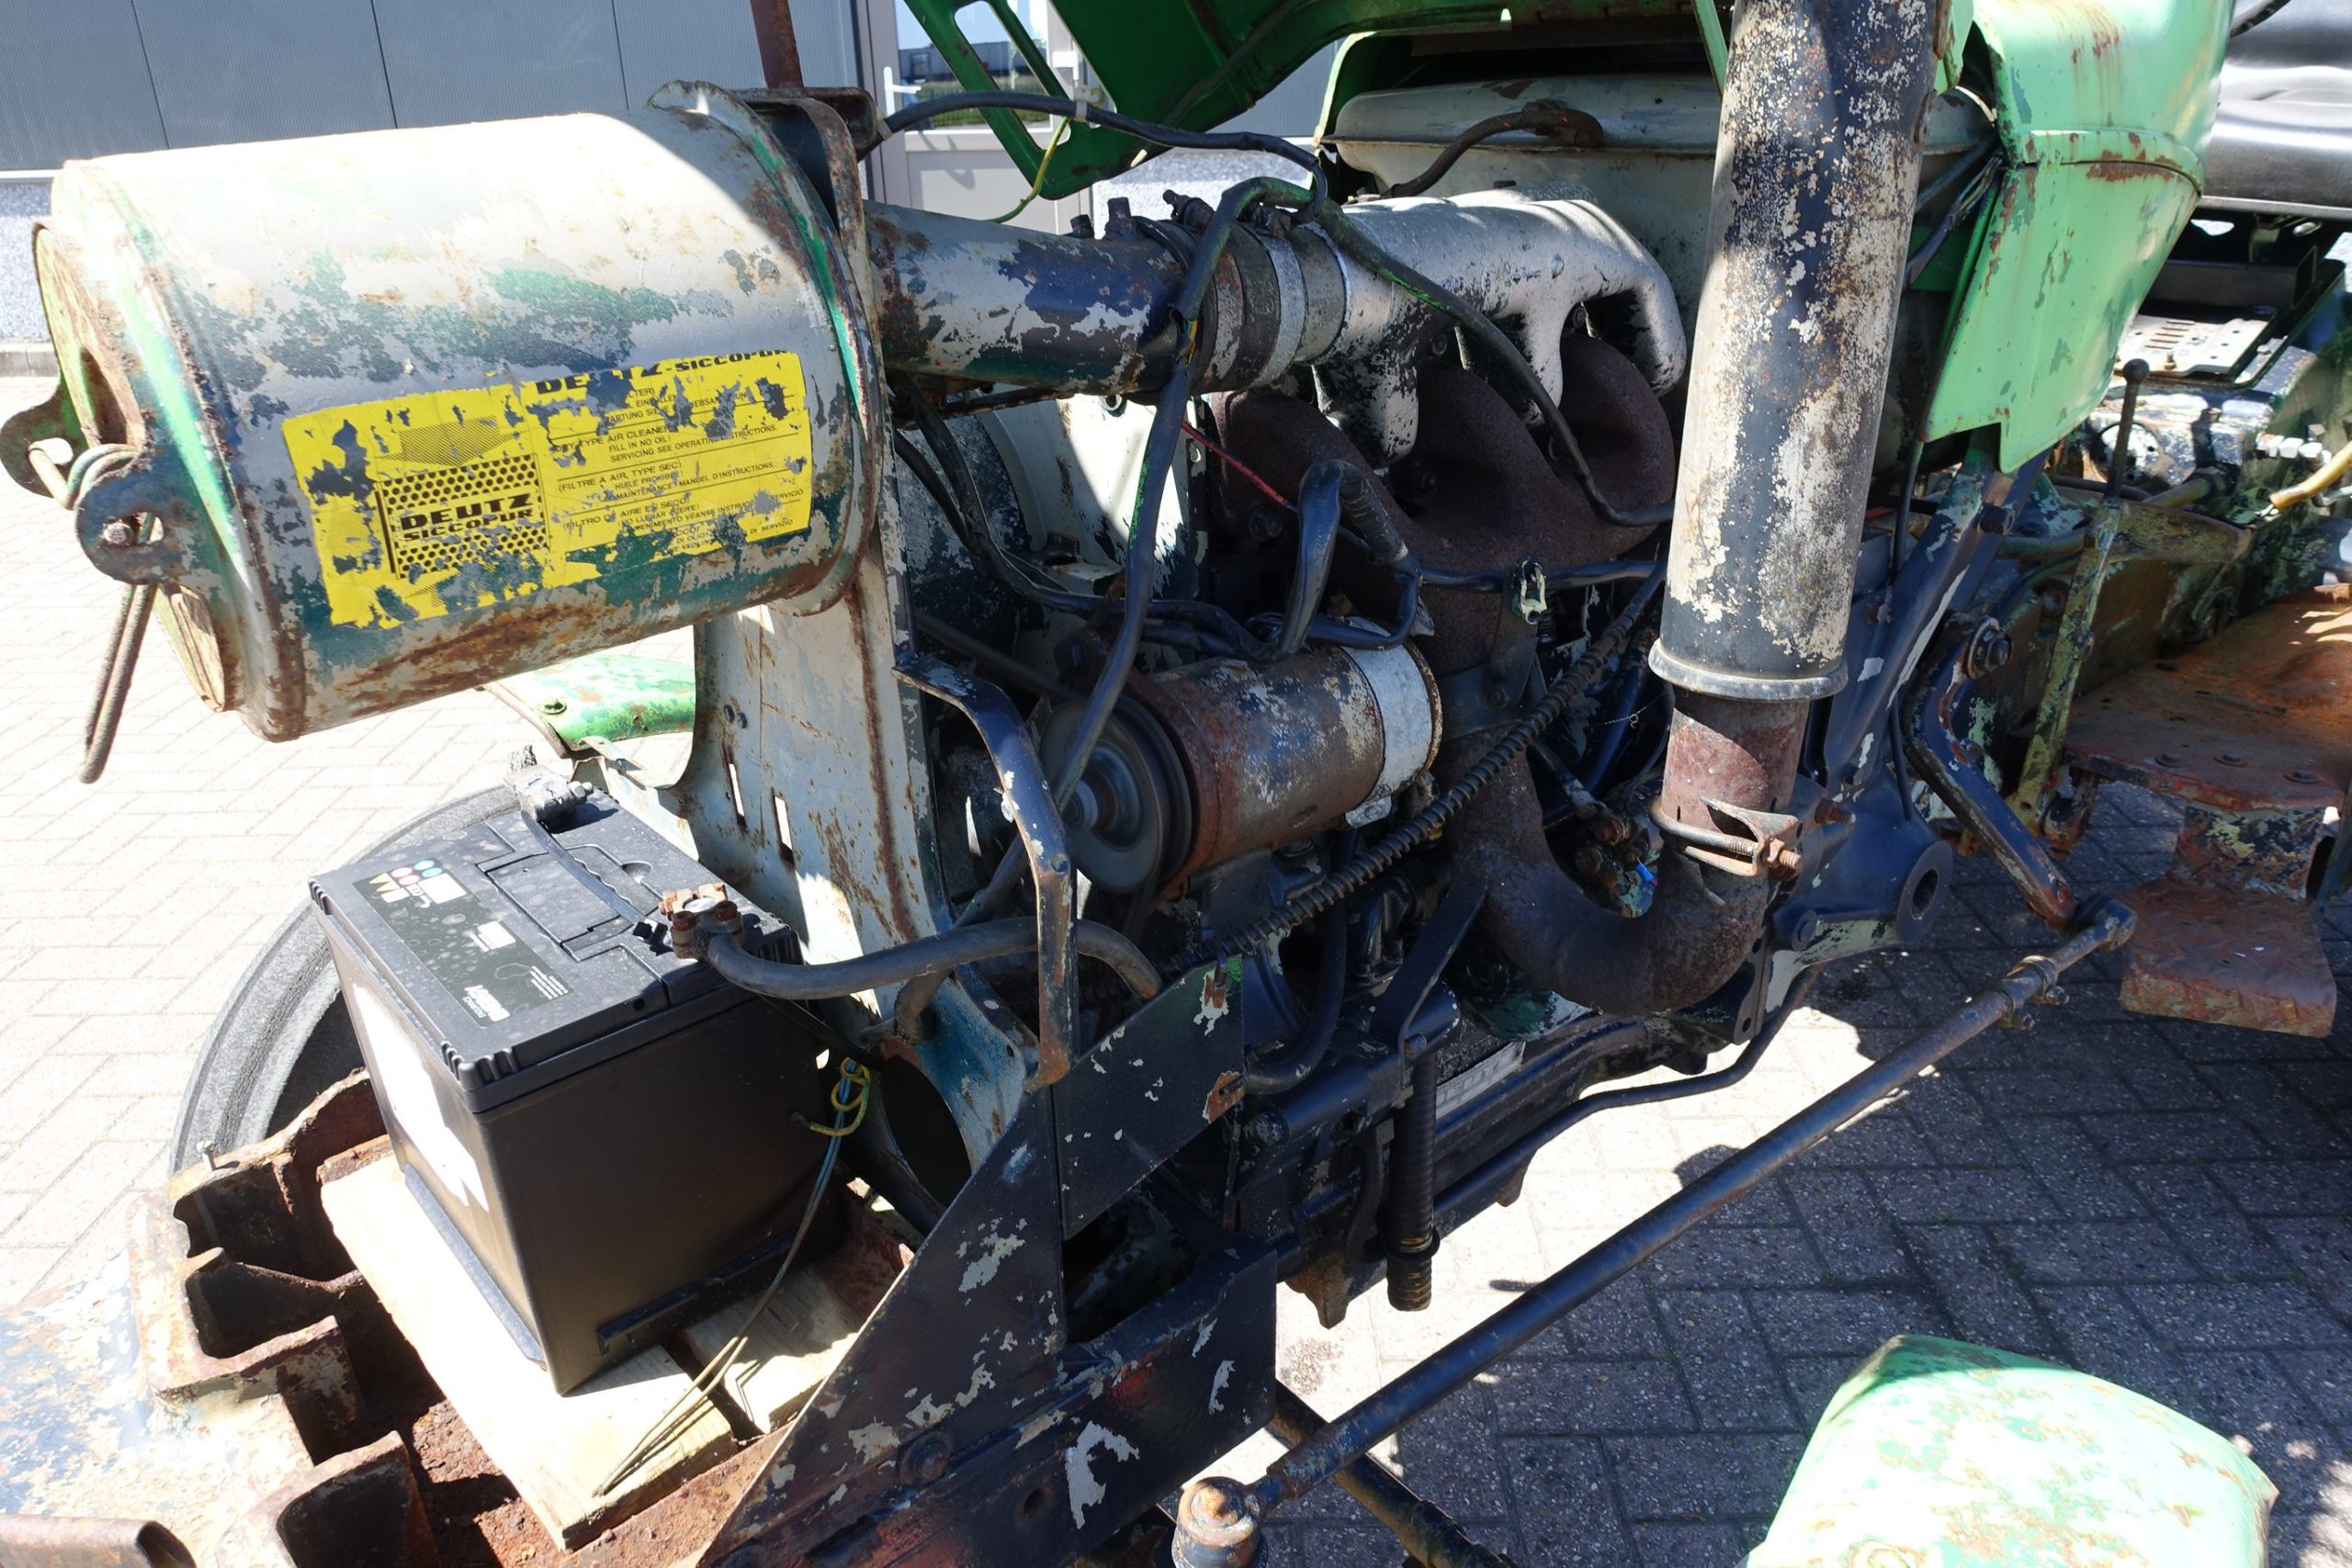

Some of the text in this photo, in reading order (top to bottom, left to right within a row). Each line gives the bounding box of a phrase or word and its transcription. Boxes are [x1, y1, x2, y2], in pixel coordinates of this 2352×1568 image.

[607, 433, 625, 444] AIR
[608, 442, 626, 453] FILL
[628, 439, 638, 448] IN
[639, 436, 652, 446] NO
[610, 447, 655, 461] SERVICING
[657, 443, 673, 454] SEE
[558, 478, 597, 493] (FILTRE
[599, 476, 606, 484] A
[631, 466, 656, 477] TYPE
[659, 460, 683, 472] SEC)
[615, 479, 639, 491] HUILE
[400, 493, 533, 530] DEUTZ
[620, 506, 641, 517] AIRE
[403, 509, 533, 541] SICCOPUR
